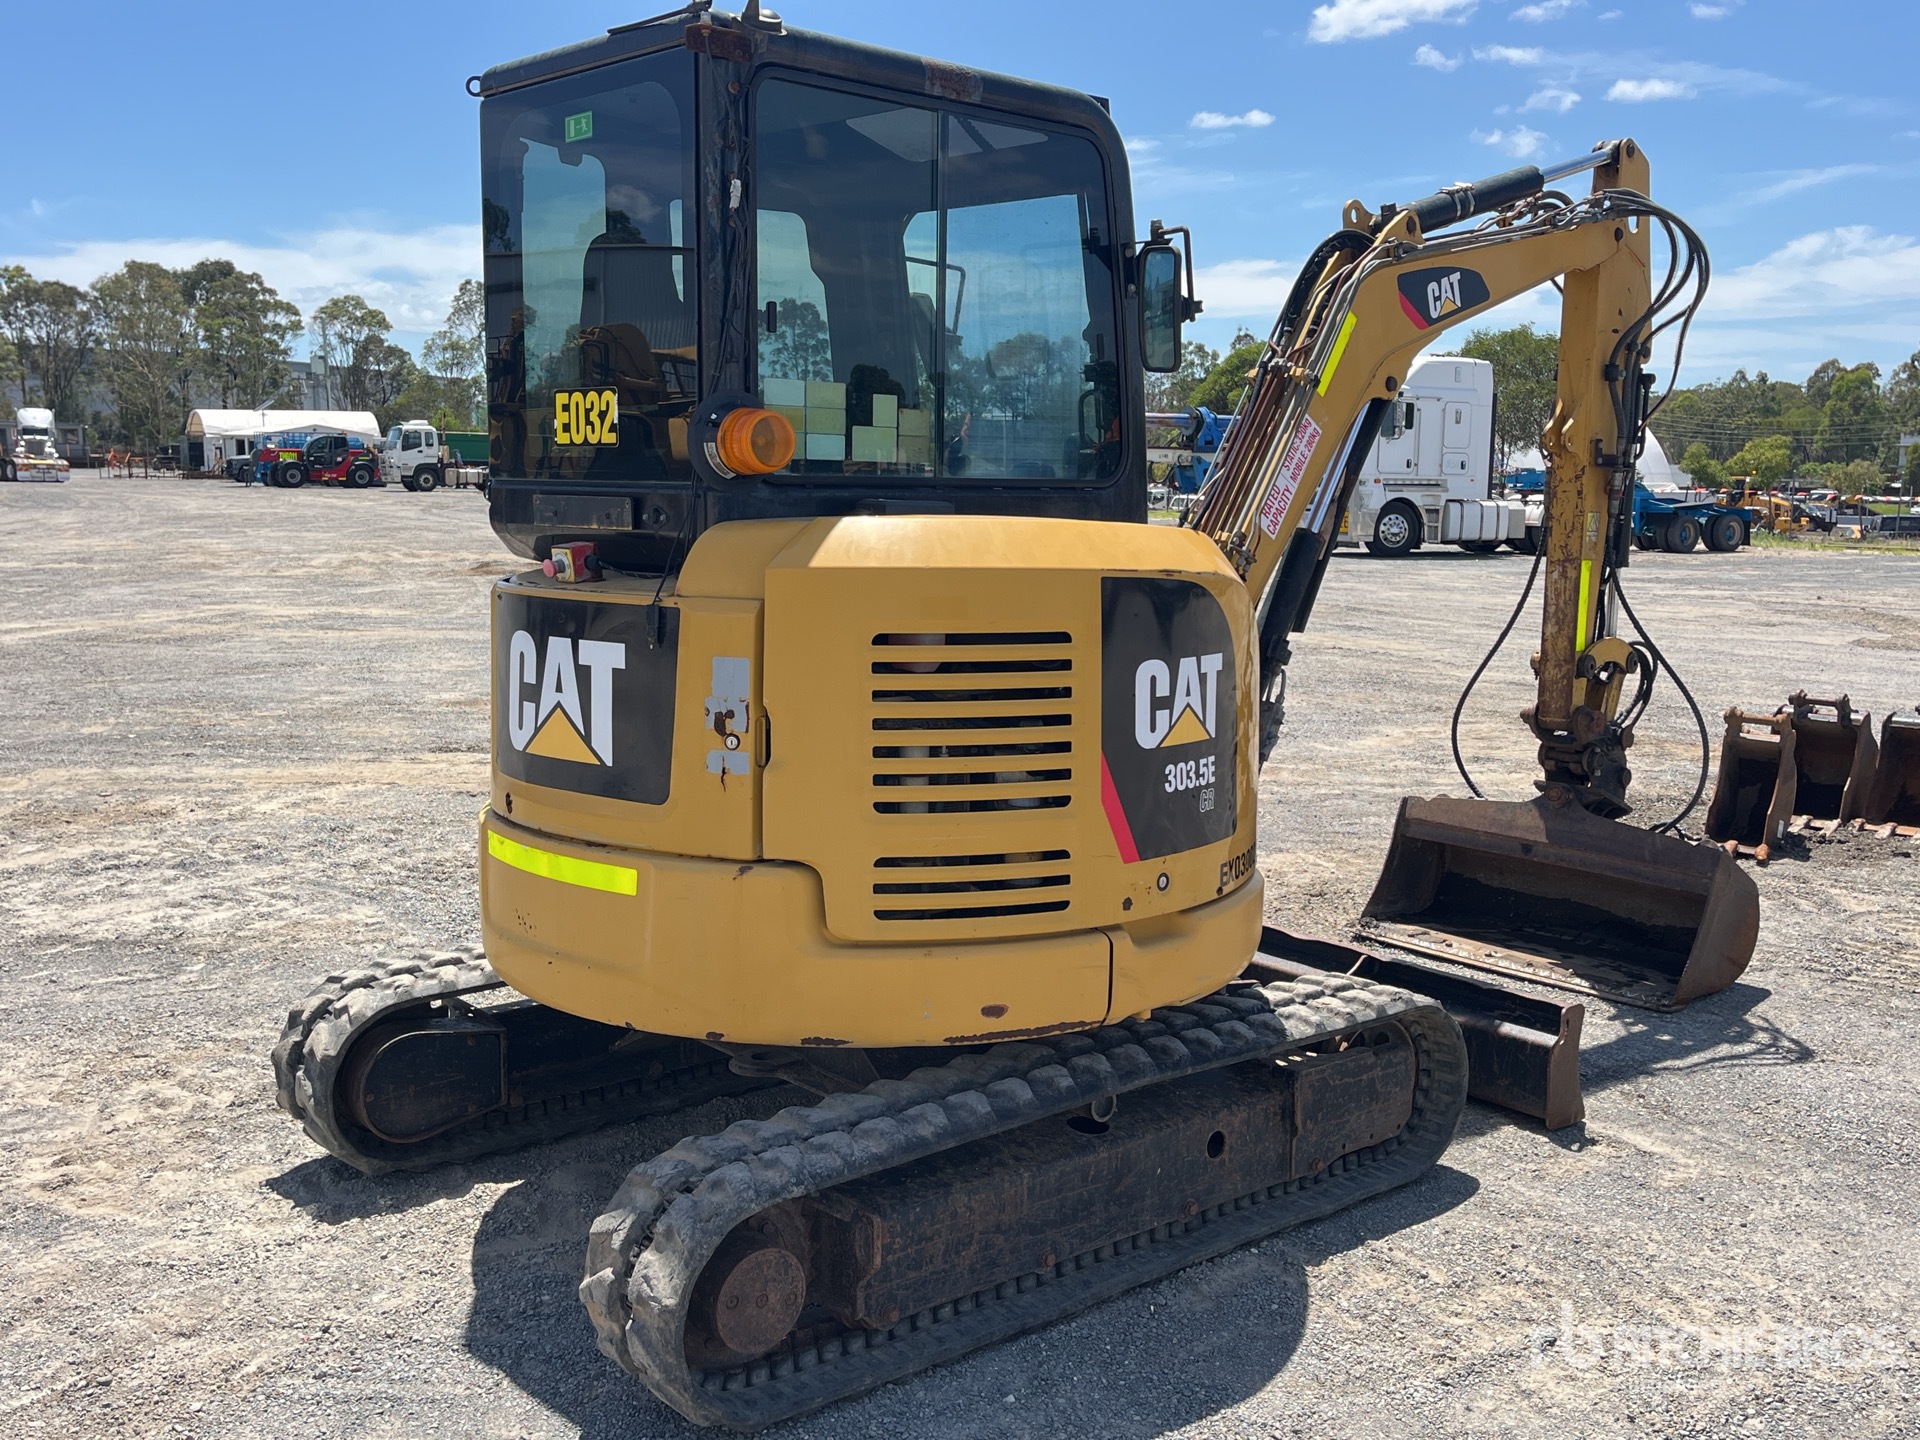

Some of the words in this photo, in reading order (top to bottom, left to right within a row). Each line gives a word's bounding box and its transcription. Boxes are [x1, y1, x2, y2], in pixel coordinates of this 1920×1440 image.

[1427, 271, 1462, 319] CAT
[556, 390, 617, 445] E032
[1261, 485, 1281, 519] RATED
[1267, 485, 1293, 535] CAPACITY
[509, 630, 626, 767] CAT
[1135, 653, 1223, 750] CAT
[1164, 755, 1216, 794] 303.5E
[1199, 788, 1215, 813] CR
